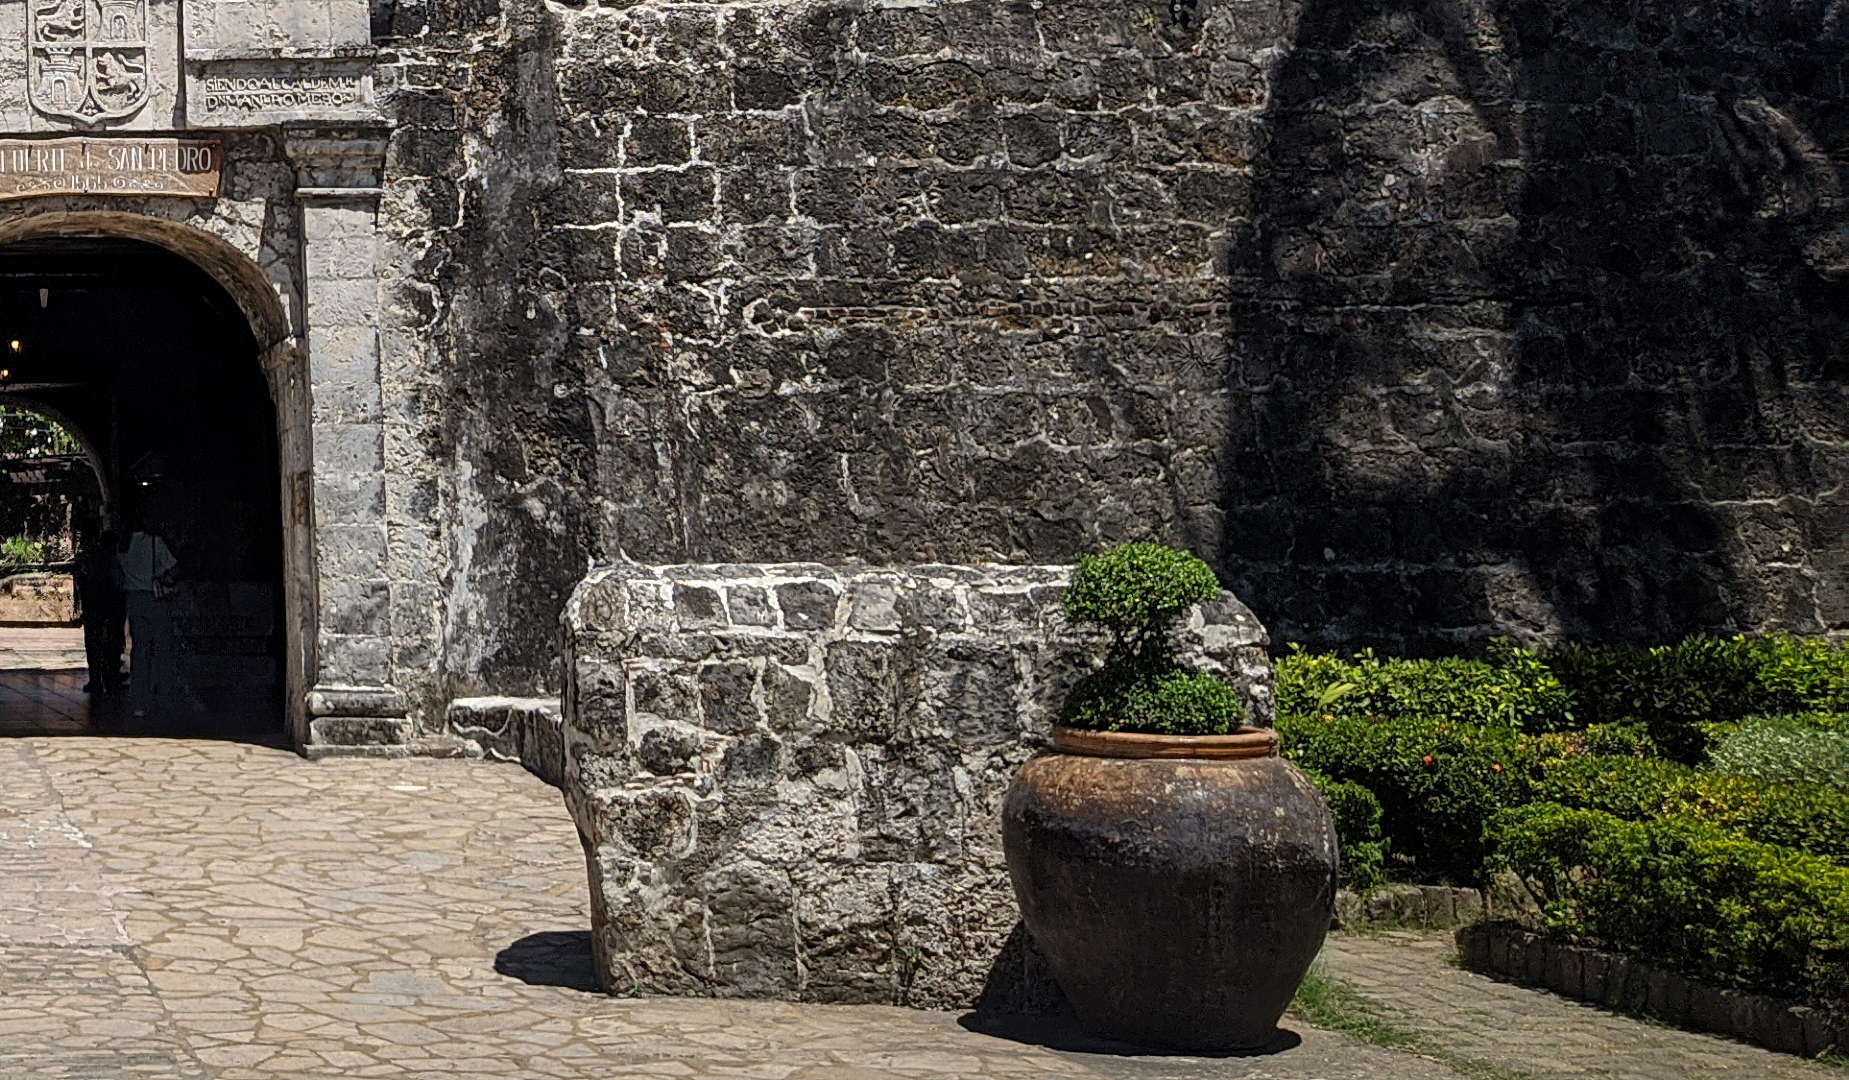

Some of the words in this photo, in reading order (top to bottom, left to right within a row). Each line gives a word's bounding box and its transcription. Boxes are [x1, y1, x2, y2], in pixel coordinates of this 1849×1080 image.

[108, 147, 143, 171] SAN
[151, 147, 212, 171] PEDRO
[71, 174, 108, 190] 1565
